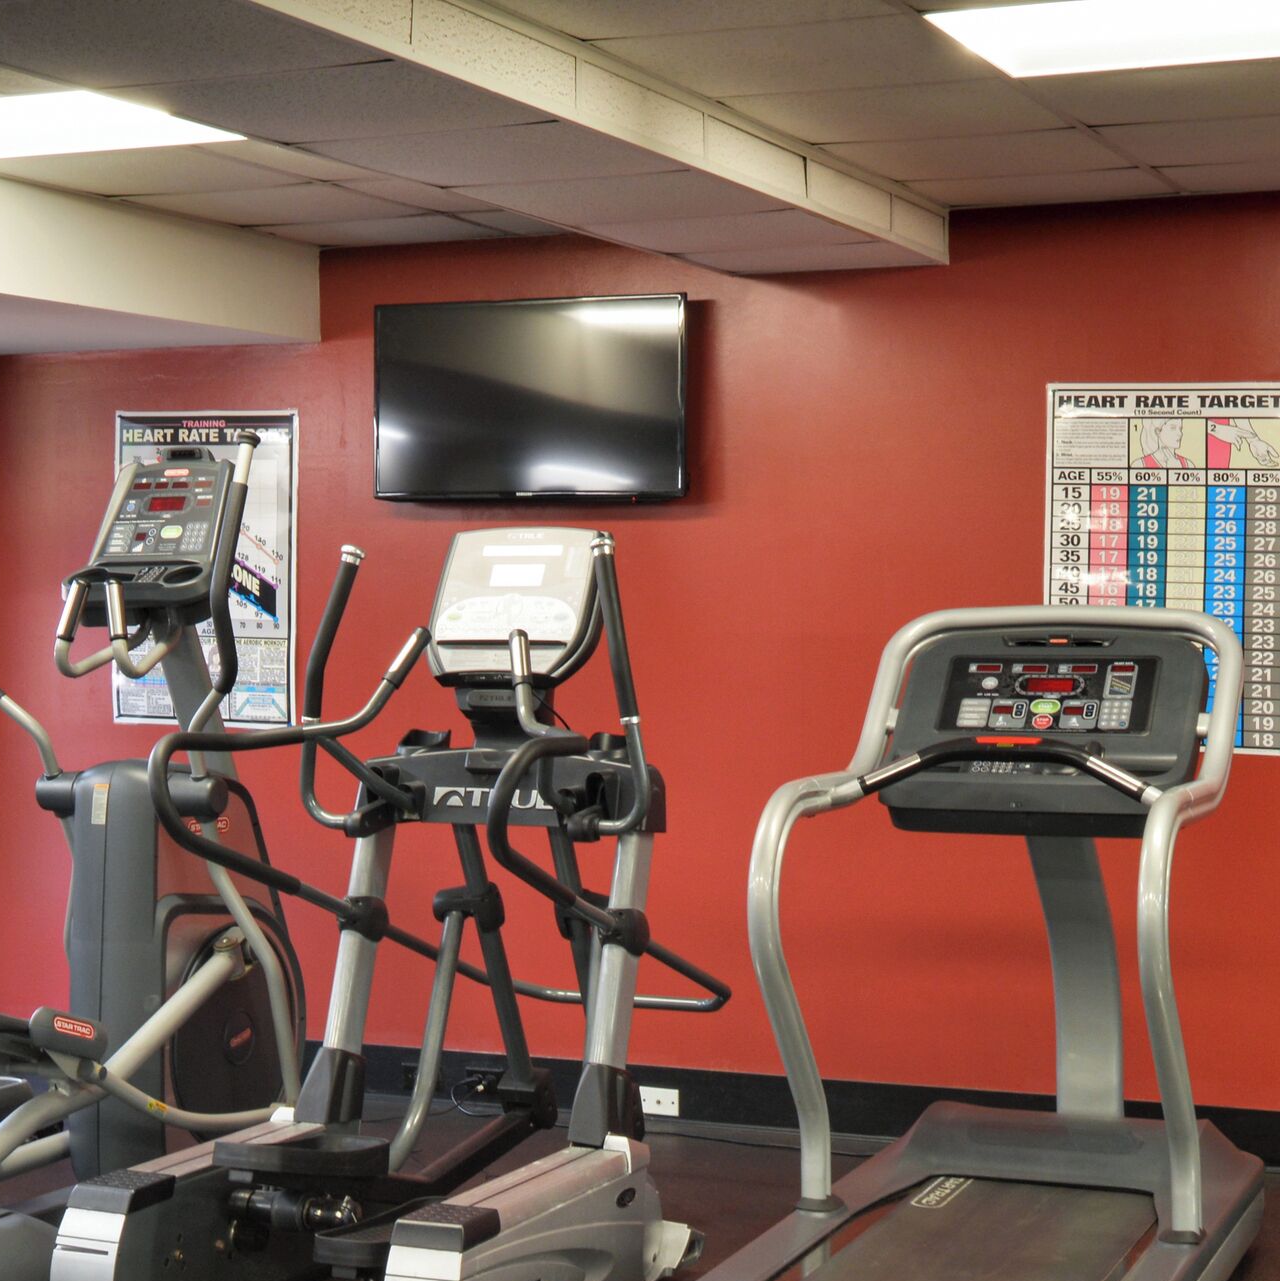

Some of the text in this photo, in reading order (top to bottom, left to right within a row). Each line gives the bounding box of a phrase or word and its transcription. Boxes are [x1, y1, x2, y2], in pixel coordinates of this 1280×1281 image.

[1058, 395, 1128, 409] HEART
[1135, 395, 1190, 409] RATE
[182, 420, 226, 428] TRAINING
[1133, 424, 1139, 432] 1
[1210, 424, 1217, 432] 2
[122, 428, 220, 443] HEART RATE
[1058, 471, 1280, 483] AGE 55% 60% 70% 80% 85%
[1061, 487, 1082, 499] 15
[1099, 486, 1121, 499] 19
[1137, 487, 1157, 500] 21
[1215, 488, 1237, 501] 27
[1254, 488, 1278, 502] 29
[1137, 503, 1159, 516] 20
[1215, 504, 1237, 517] 27
[1254, 504, 1277, 518] 28
[1137, 519, 1159, 533] 19
[1214, 520, 1237, 534] 26
[1254, 520, 1276, 534] 28
[1060, 534, 1081, 547] 30
[1099, 535, 1118, 547] 17
[1137, 535, 1159, 549] 19
[1214, 536, 1236, 550] 25
[1254, 537, 1276, 551] 27
[1059, 550, 1081, 563] 35
[1098, 551, 1118, 564] 17
[1137, 551, 1158, 565] 19
[1214, 553, 1236, 567] 25
[1253, 553, 1276, 567] 26
[231, 563, 261, 597] ONE
[1137, 567, 1158, 580] 18
[1213, 569, 1236, 583] 24
[1253, 569, 1276, 584] 26
[1058, 582, 1080, 595] 45
[1098, 583, 1118, 595] 16
[1136, 583, 1158, 597] 18
[1213, 585, 1236, 599] 23
[1253, 586, 1275, 600] 25
[1212, 601, 1235, 615] 23
[1252, 602, 1275, 616] 24
[1252, 618, 1275, 633] 23
[1252, 635, 1275, 649] 23
[1251, 651, 1274, 665] 22
[1251, 667, 1272, 681] 21
[1251, 684, 1272, 698] 21
[1251, 700, 1274, 714] 20
[1252, 716, 1274, 730] 19
[1252, 733, 1274, 747] 18
[56, 1020, 91, 1035] STAR TRAC
